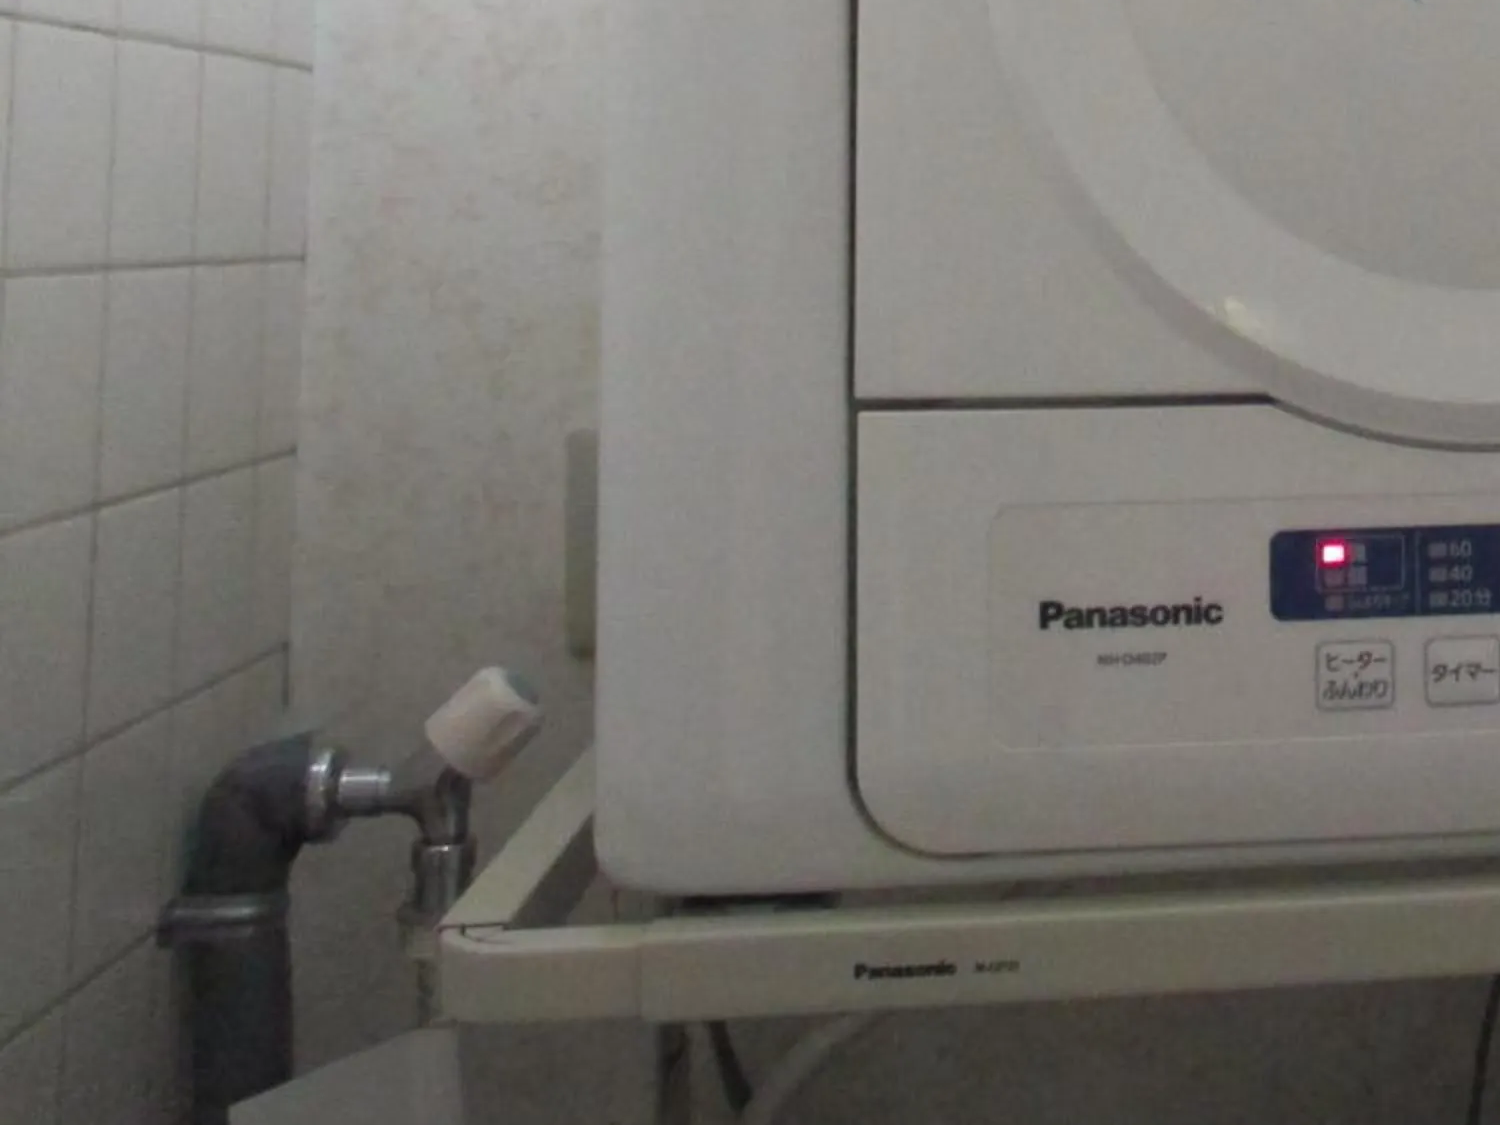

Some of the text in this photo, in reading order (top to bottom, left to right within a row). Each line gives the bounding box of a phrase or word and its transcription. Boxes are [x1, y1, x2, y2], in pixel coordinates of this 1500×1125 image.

[1038, 596, 1224, 631] Panasonic
[1324, 650, 1388, 673] ヒーター
[1431, 661, 1497, 683] タイマー
[1322, 678, 1389, 701] ふんわり
